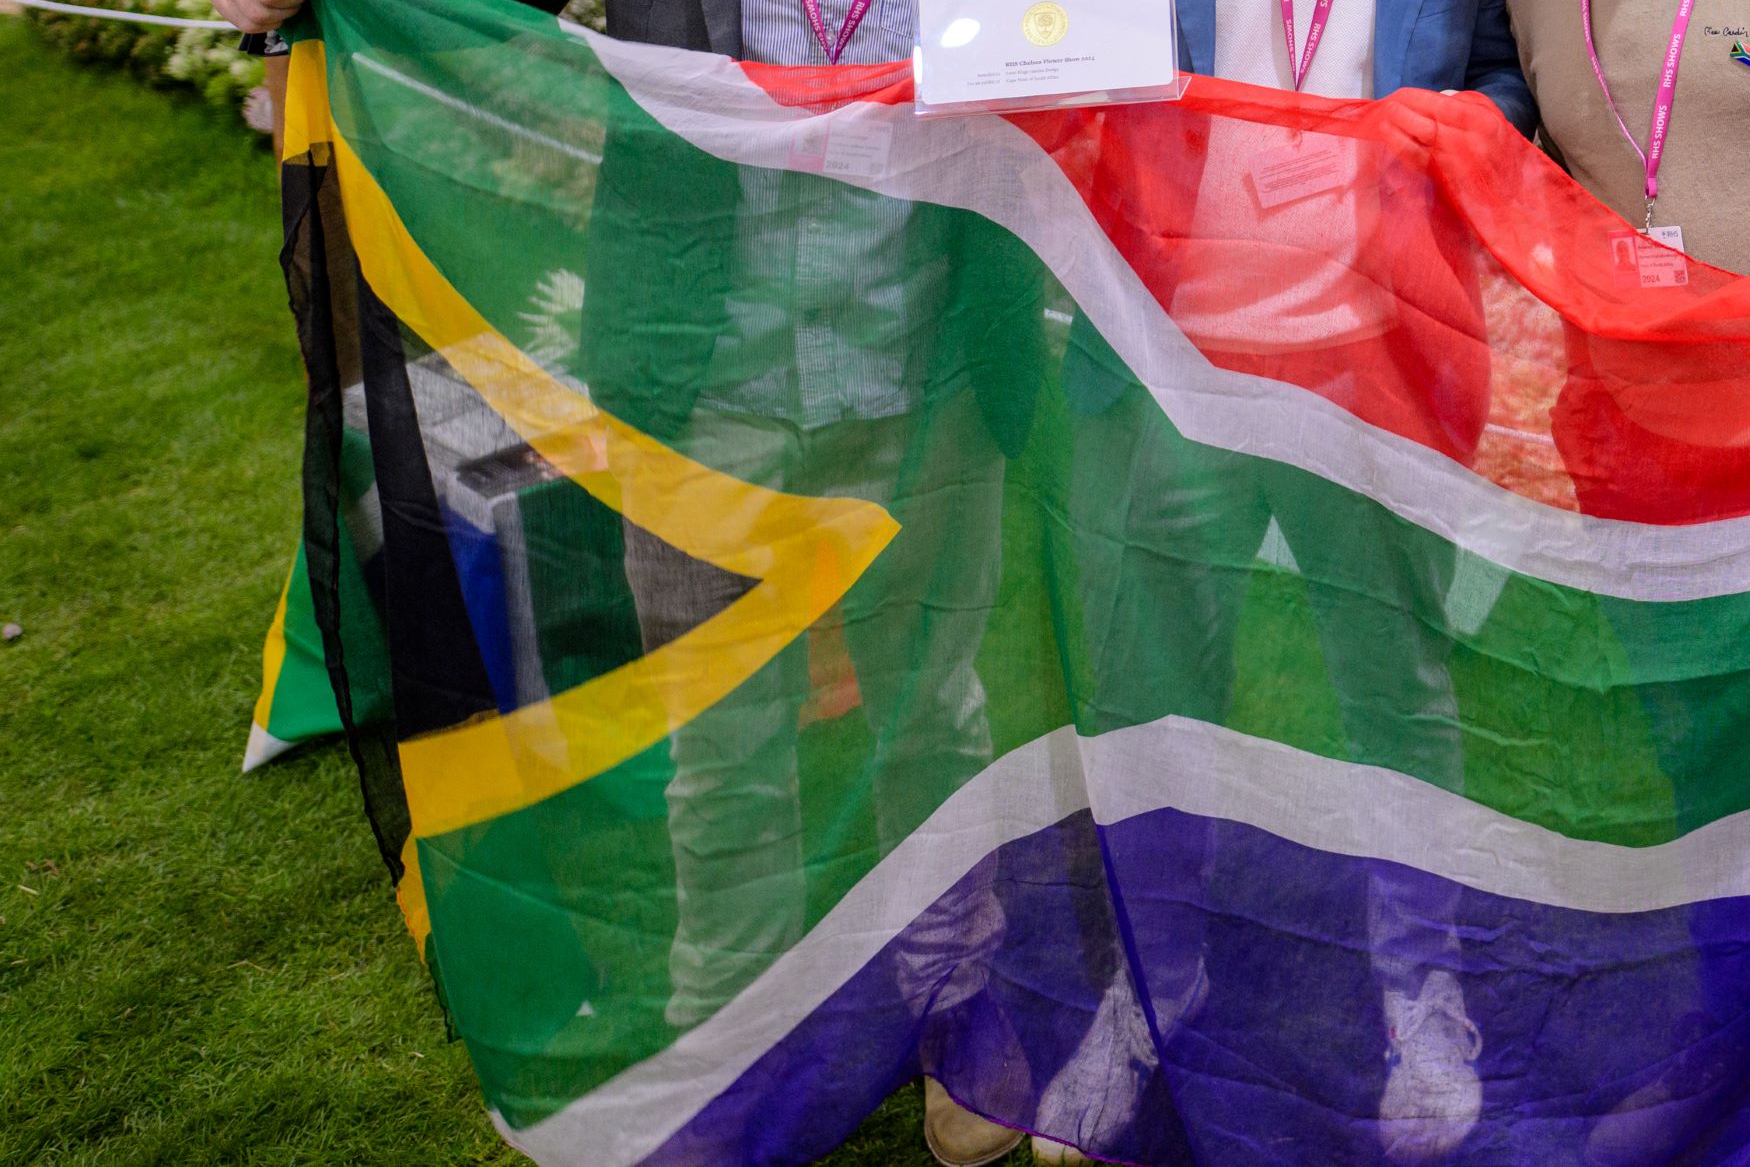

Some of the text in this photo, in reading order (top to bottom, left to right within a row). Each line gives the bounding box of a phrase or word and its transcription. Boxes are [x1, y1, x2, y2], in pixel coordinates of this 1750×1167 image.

[852, 2, 865, 19] RHS
[1680, 0, 1690, 17] RHS
[1301, 24, 1321, 74] RHS SHOWS
[1663, 34, 1681, 87] RHS SHOWS
[1652, 105, 1667, 158] RHS SHOWS
[826, 161, 850, 170] 2024
[1642, 275, 1660, 283] 2024
